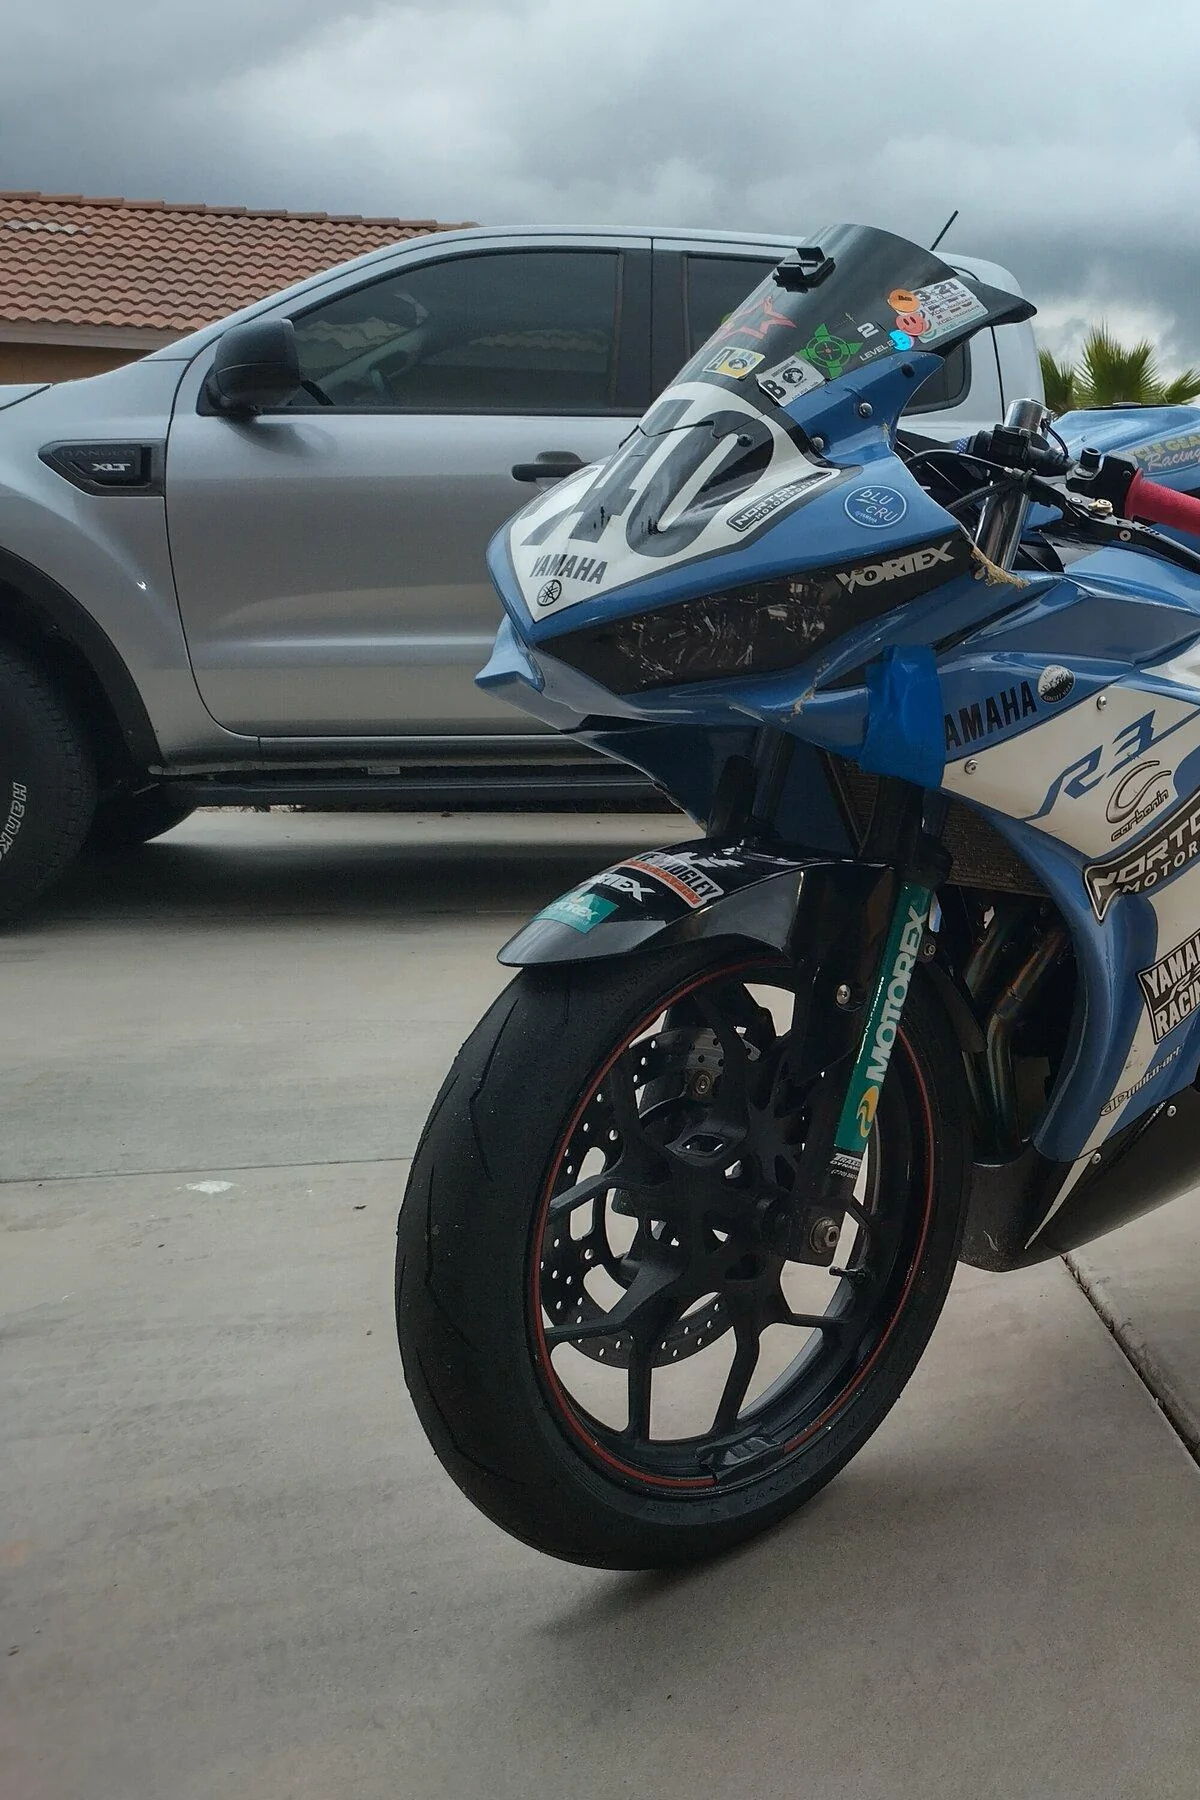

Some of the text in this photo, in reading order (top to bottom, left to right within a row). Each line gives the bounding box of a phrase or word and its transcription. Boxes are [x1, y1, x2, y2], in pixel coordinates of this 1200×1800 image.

[857, 322, 880, 339] 2
[860, 344, 888, 361] LEVEL
[763, 379, 787, 400] B
[91, 463, 131, 472] XLT
[735, 484, 797, 526] NORTON
[529, 553, 608, 585] YAMAHA
[836, 540, 955, 594] VORTEX
[944, 681, 1038, 752] AMAHA
[865, 904, 929, 1083] MOTOREX
